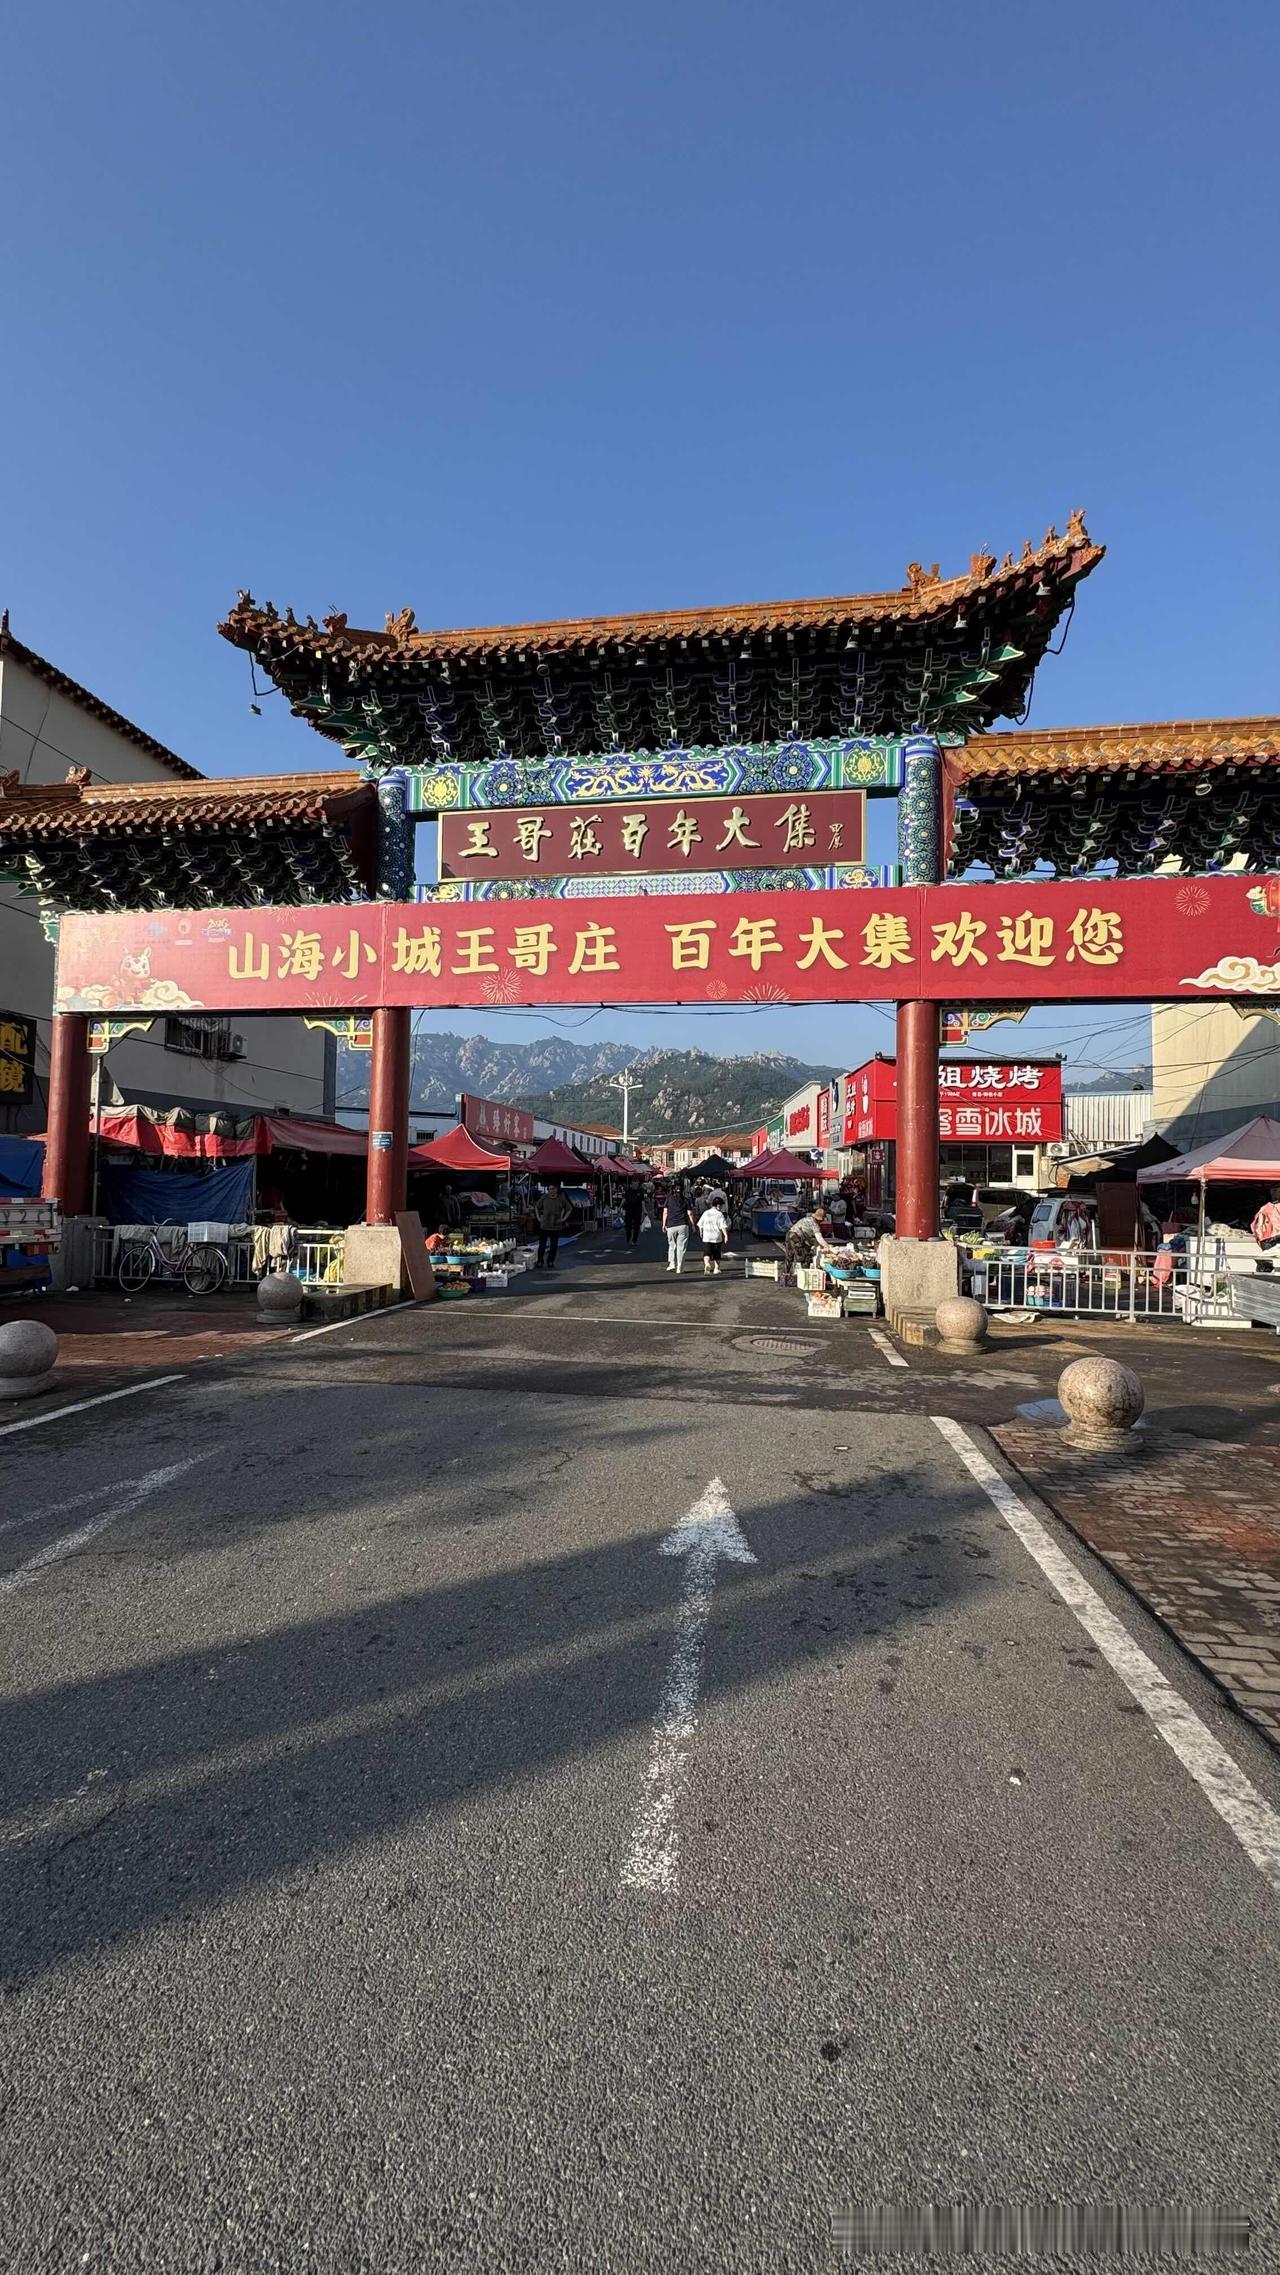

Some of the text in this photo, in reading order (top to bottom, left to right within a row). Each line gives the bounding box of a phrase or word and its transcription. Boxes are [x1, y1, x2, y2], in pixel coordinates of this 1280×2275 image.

[228, 907, 1125, 982] 山海小城王哥庄 百年大集欢迎您
[893, 1065, 1044, 1090] 姐烧烤
